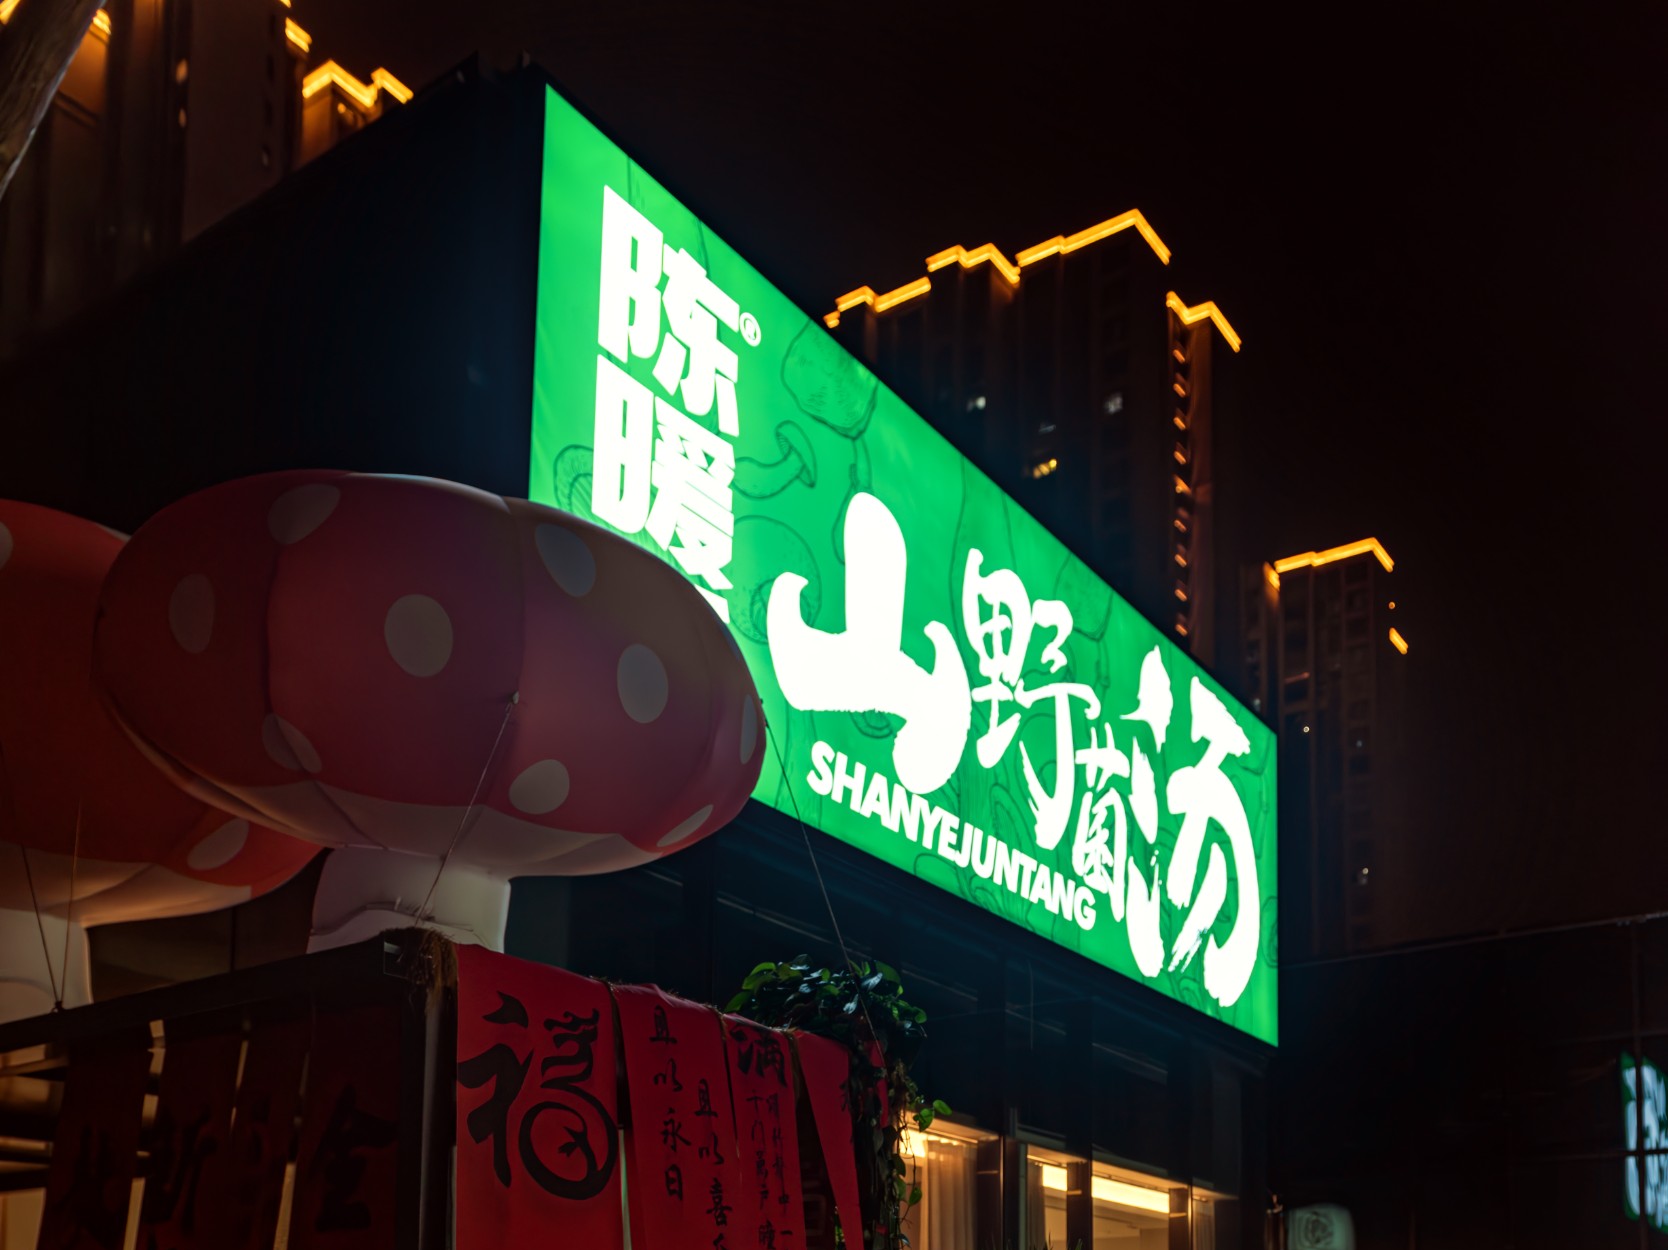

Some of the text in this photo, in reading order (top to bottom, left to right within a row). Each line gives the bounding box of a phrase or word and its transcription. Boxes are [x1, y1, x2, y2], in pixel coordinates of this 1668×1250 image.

[591, 184, 741, 626] 陈暖
[806, 740, 1096, 930] SHANYEJUNTANG
[458, 991, 618, 1200] 福
